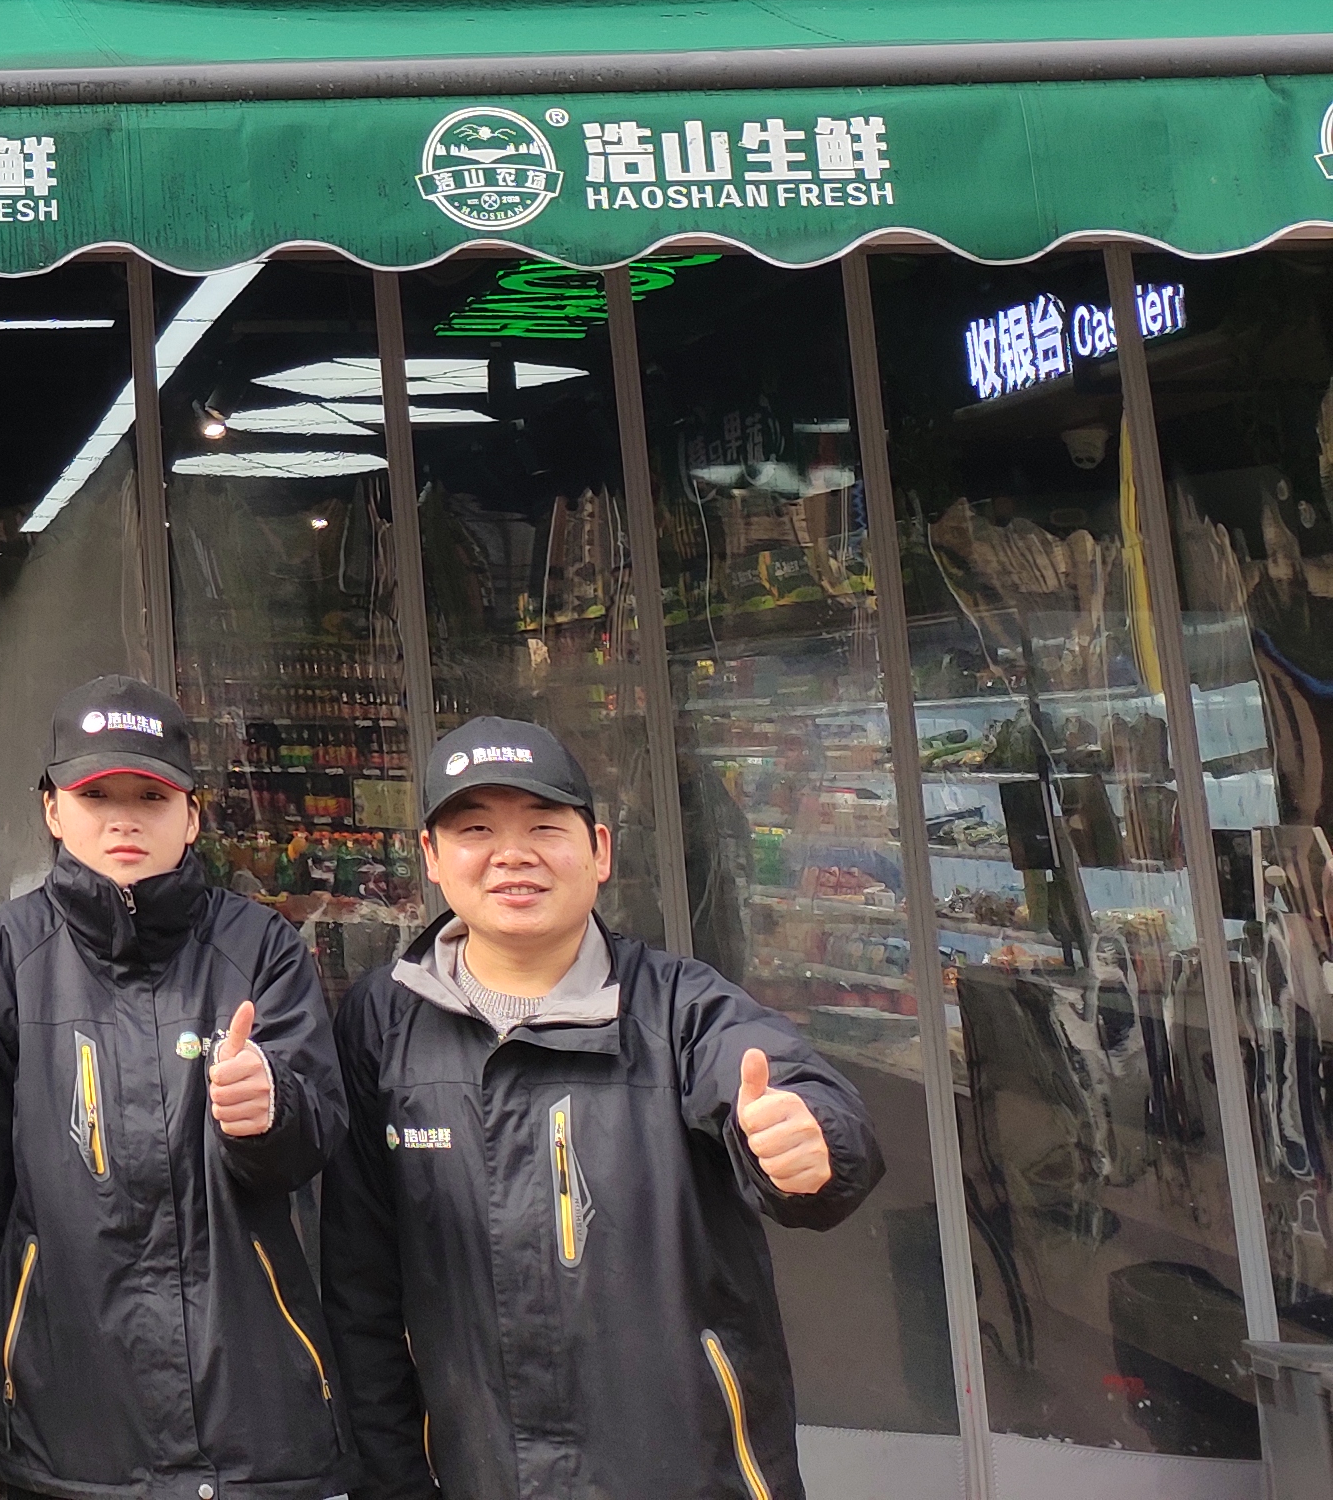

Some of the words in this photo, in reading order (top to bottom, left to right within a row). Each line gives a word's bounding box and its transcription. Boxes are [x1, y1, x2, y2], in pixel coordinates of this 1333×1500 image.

[582, 115, 890, 185] 浩山生鲜
[966, 294, 1067, 399] 收银台
[1073, 284, 1181, 357] Casier
